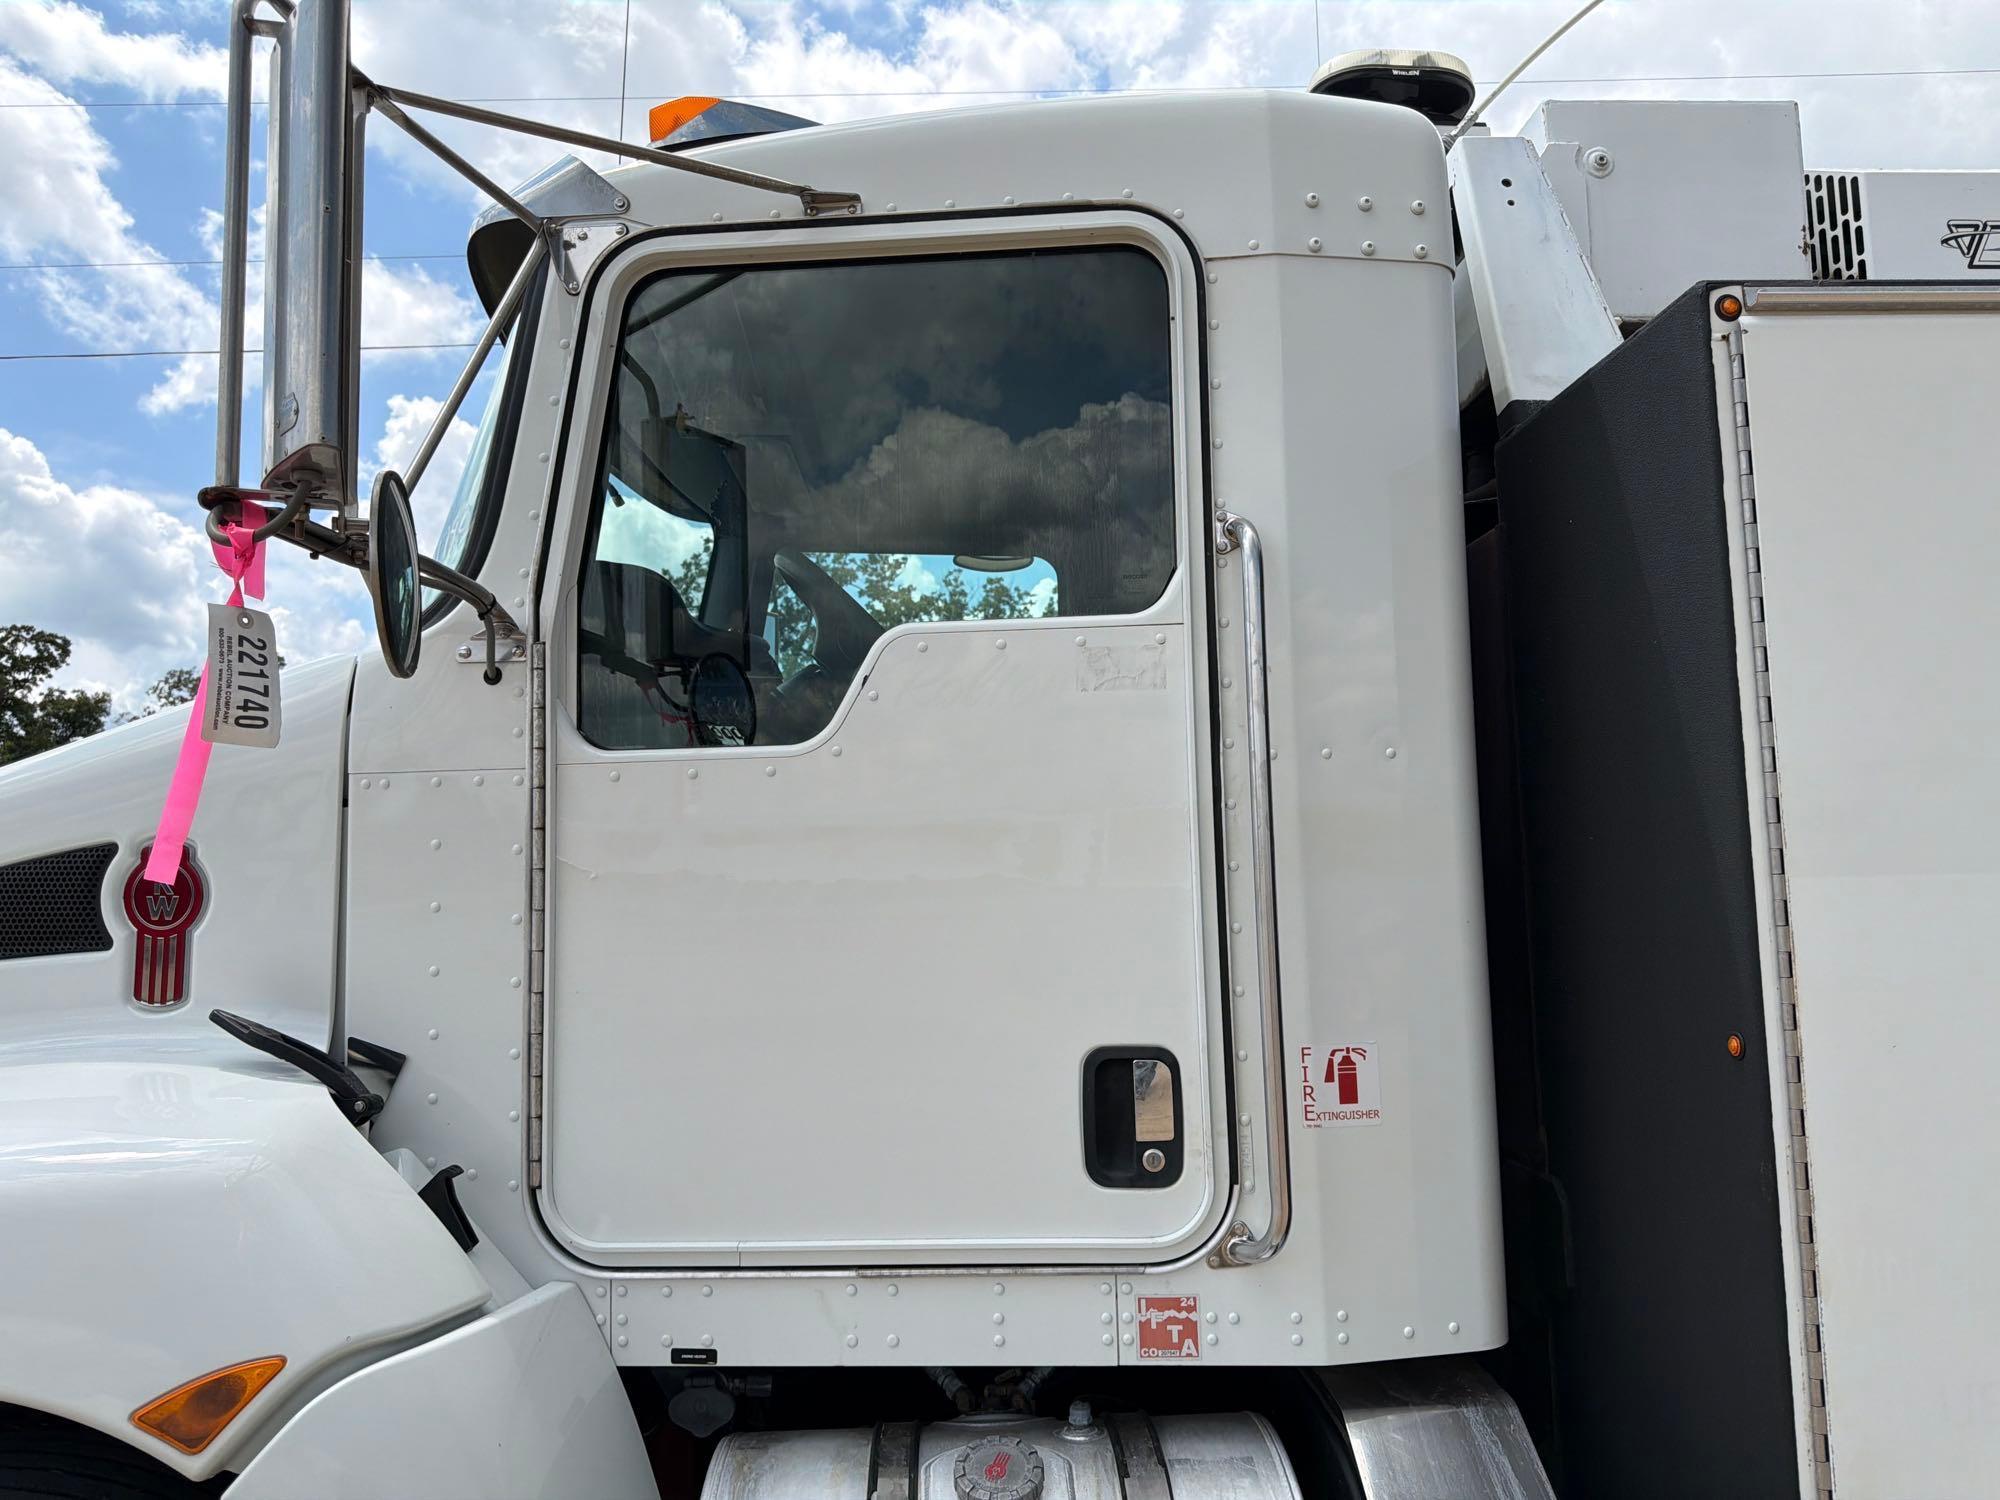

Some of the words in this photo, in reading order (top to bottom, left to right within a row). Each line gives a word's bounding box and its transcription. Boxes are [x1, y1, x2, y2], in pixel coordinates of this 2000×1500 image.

[213, 668, 223, 730] www.rebelauction.com
[234, 634, 269, 730] 221740
[222, 690, 232, 724] COMPANY
[1180, 1297, 1195, 1308] 24
[1140, 1347, 1158, 1357] CO
